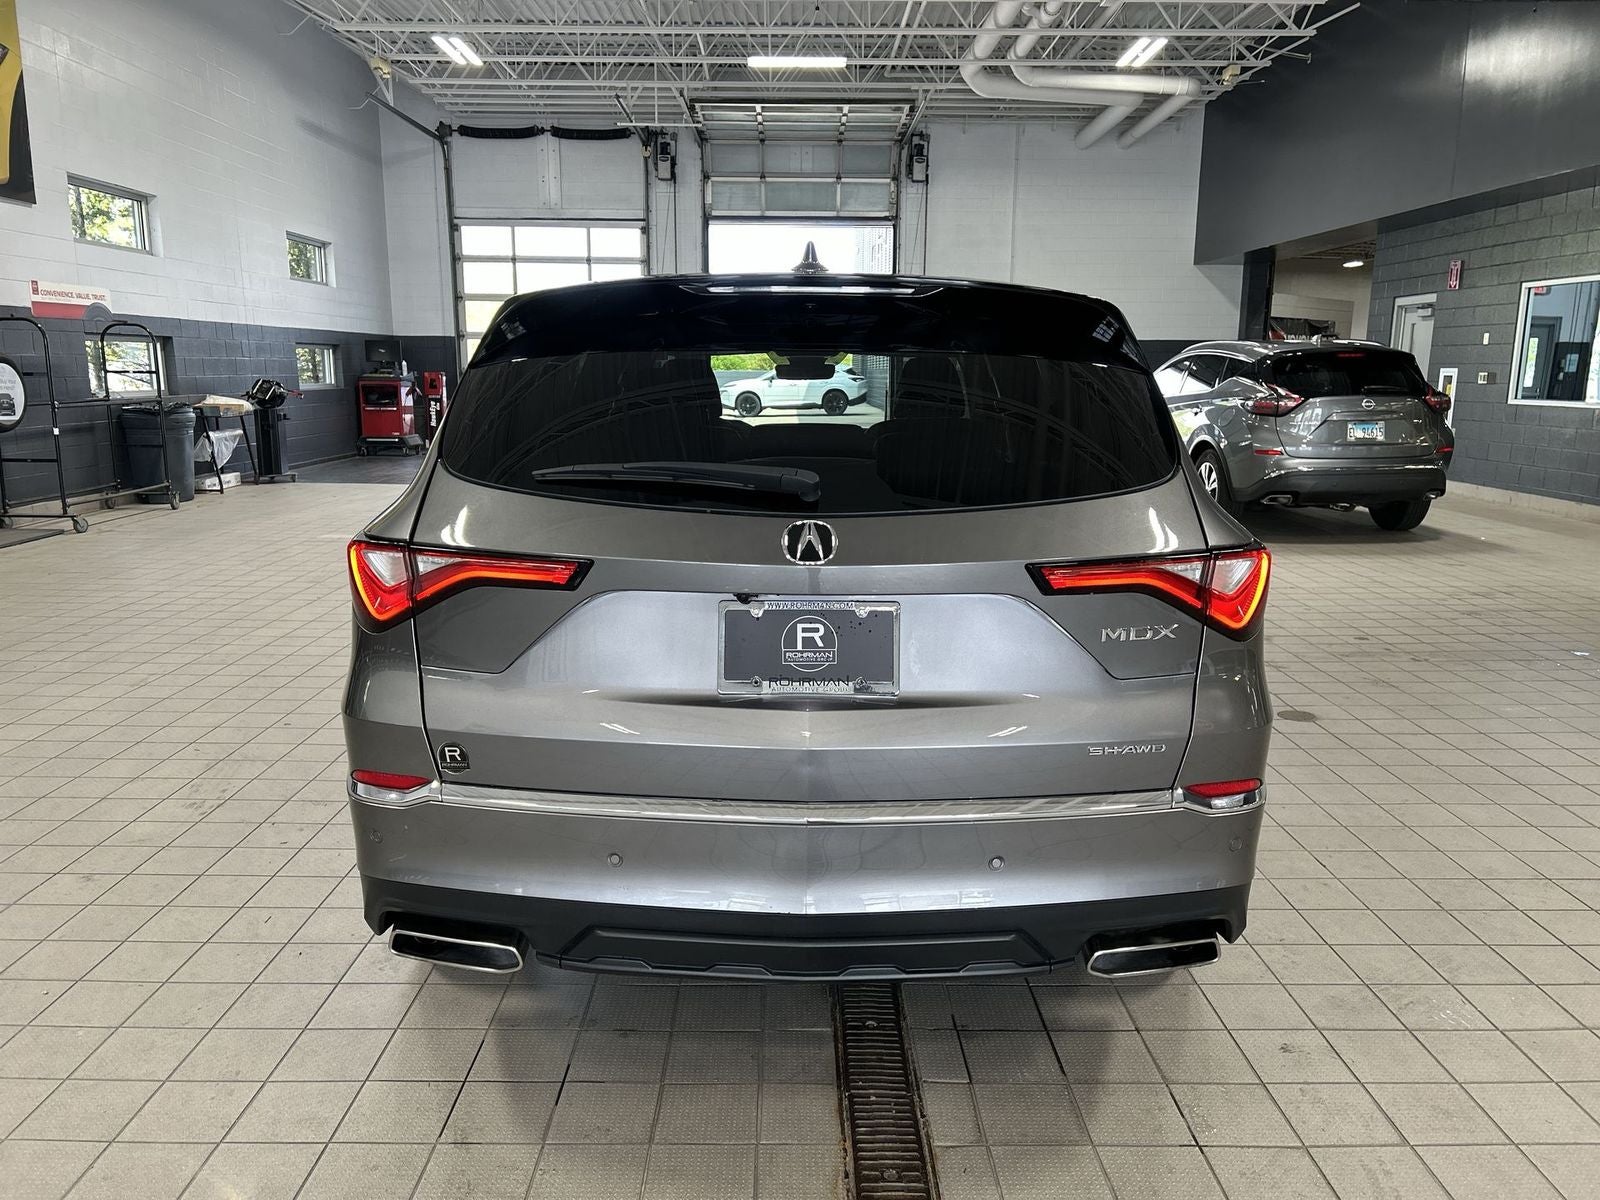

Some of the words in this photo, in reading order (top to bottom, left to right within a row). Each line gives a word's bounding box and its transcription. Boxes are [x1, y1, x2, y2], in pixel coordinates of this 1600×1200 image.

[767, 602, 854, 610] WWW.ROHRMAN.COM
[797, 623, 825, 650] R
[1101, 624, 1179, 642] MDX
[769, 676, 849, 688] ROHRMAN
[445, 747, 461, 762] R
[1088, 744, 1167, 756] SH-AWD
